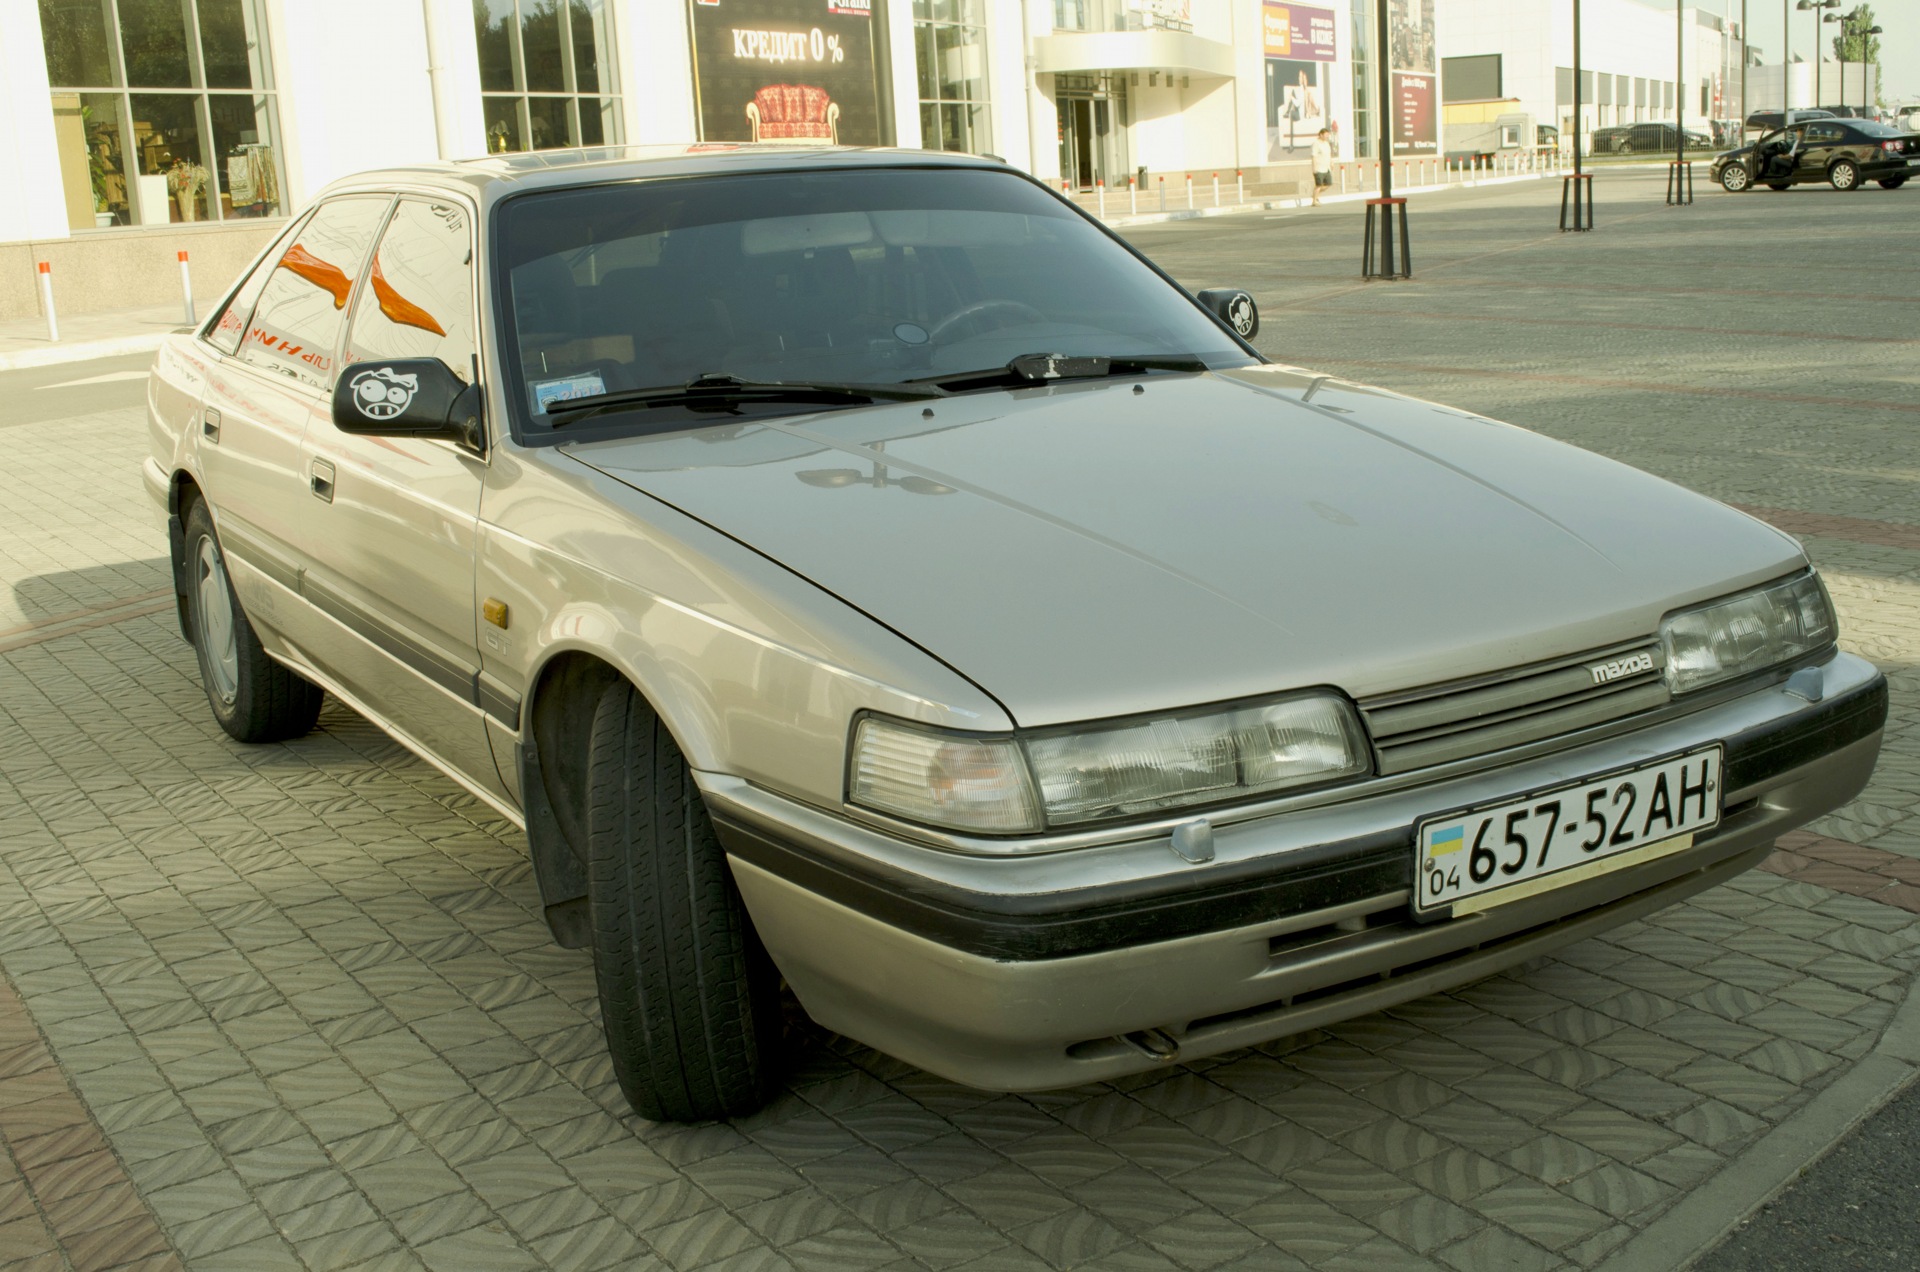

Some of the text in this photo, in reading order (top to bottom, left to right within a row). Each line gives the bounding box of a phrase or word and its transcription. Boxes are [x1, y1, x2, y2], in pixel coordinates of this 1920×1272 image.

[732, 28, 807, 63] КРЕДИТ
[810, 27, 824, 62] 0
[1468, 758, 1709, 884] 657-52AH
[1430, 864, 1461, 896] 04
